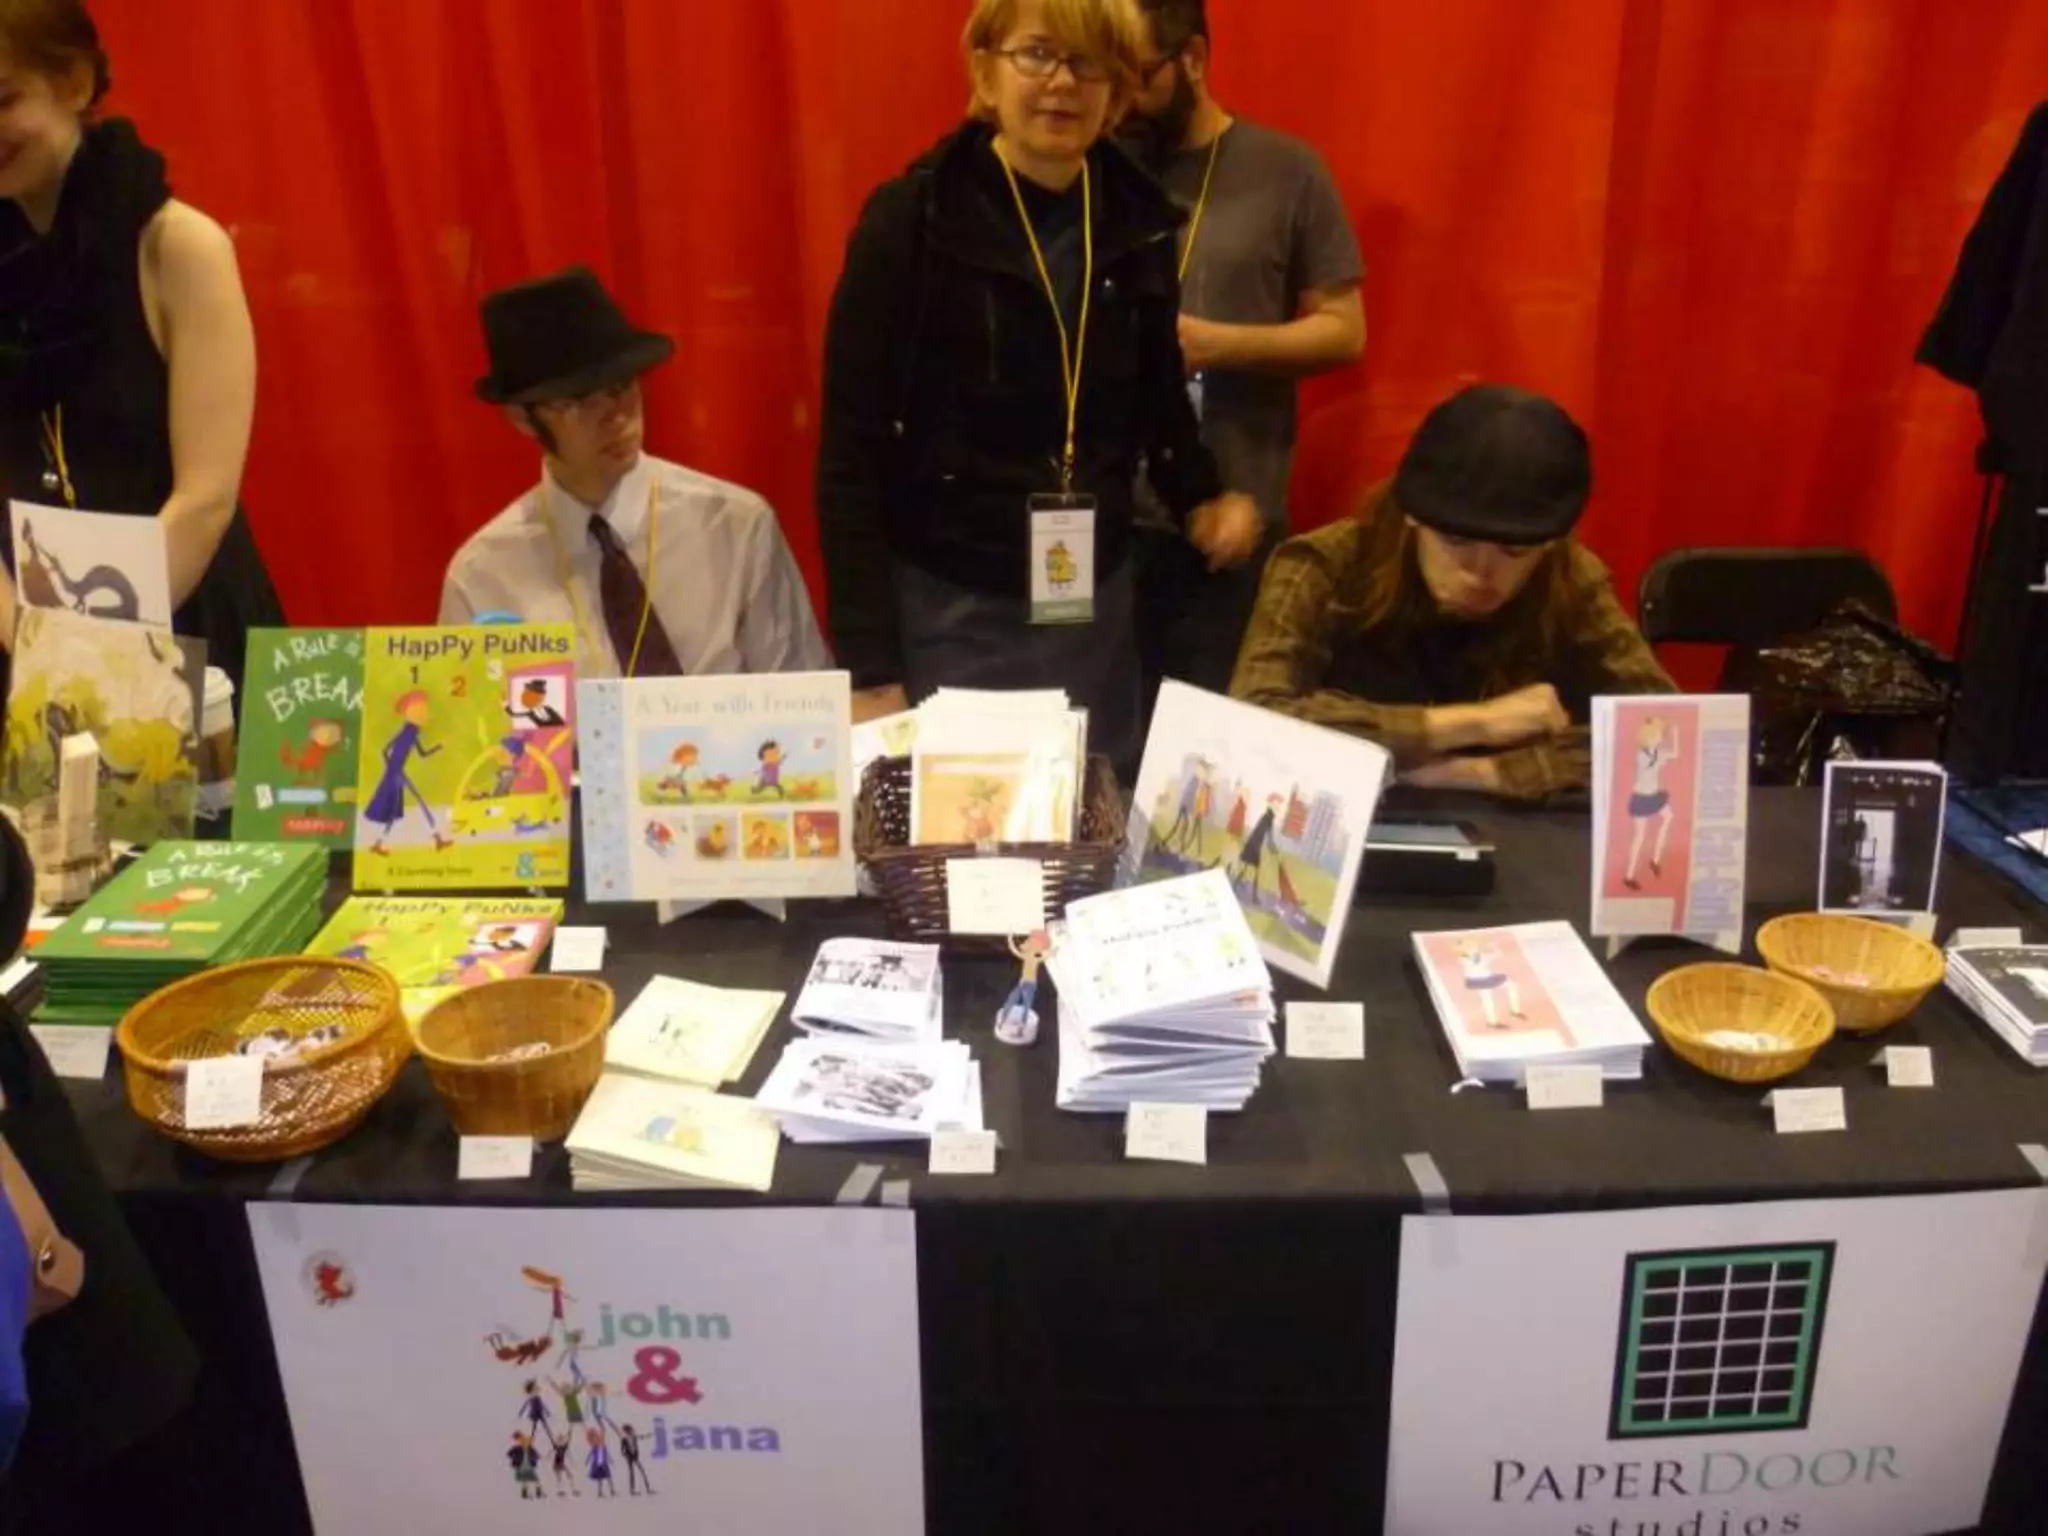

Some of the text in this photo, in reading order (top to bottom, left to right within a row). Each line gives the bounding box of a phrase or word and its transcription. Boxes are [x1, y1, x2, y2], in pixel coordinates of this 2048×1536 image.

[273, 647, 290, 674] A
[409, 665, 418, 685] 1
[450, 675, 468, 698] 2
[598, 1303, 732, 1347] john
[627, 1345, 704, 1406] &
[651, 1416, 782, 1460] jana
[1574, 1509, 1803, 1536] studios
